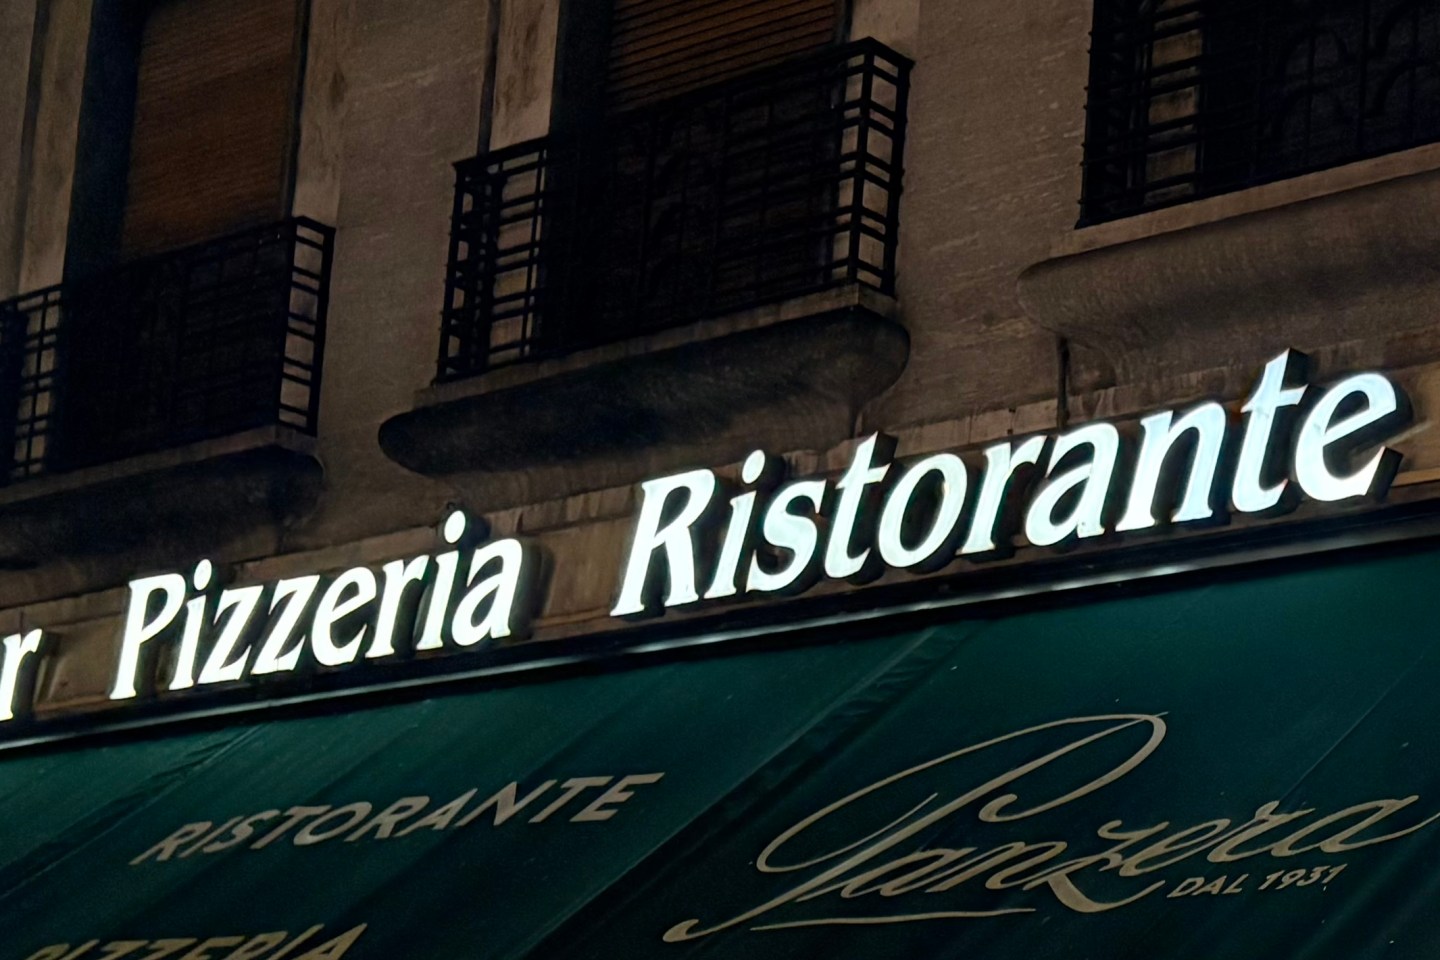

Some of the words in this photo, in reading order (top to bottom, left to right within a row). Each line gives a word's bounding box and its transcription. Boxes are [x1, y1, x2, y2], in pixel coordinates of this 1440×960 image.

[109, 510, 523, 700] Pizzeria
[610, 348, 1397, 616] Ristorante
[130, 772, 664, 866] RISTORANTE
[1167, 874, 1249, 898] DAL
[1258, 863, 1347, 891] 1931
